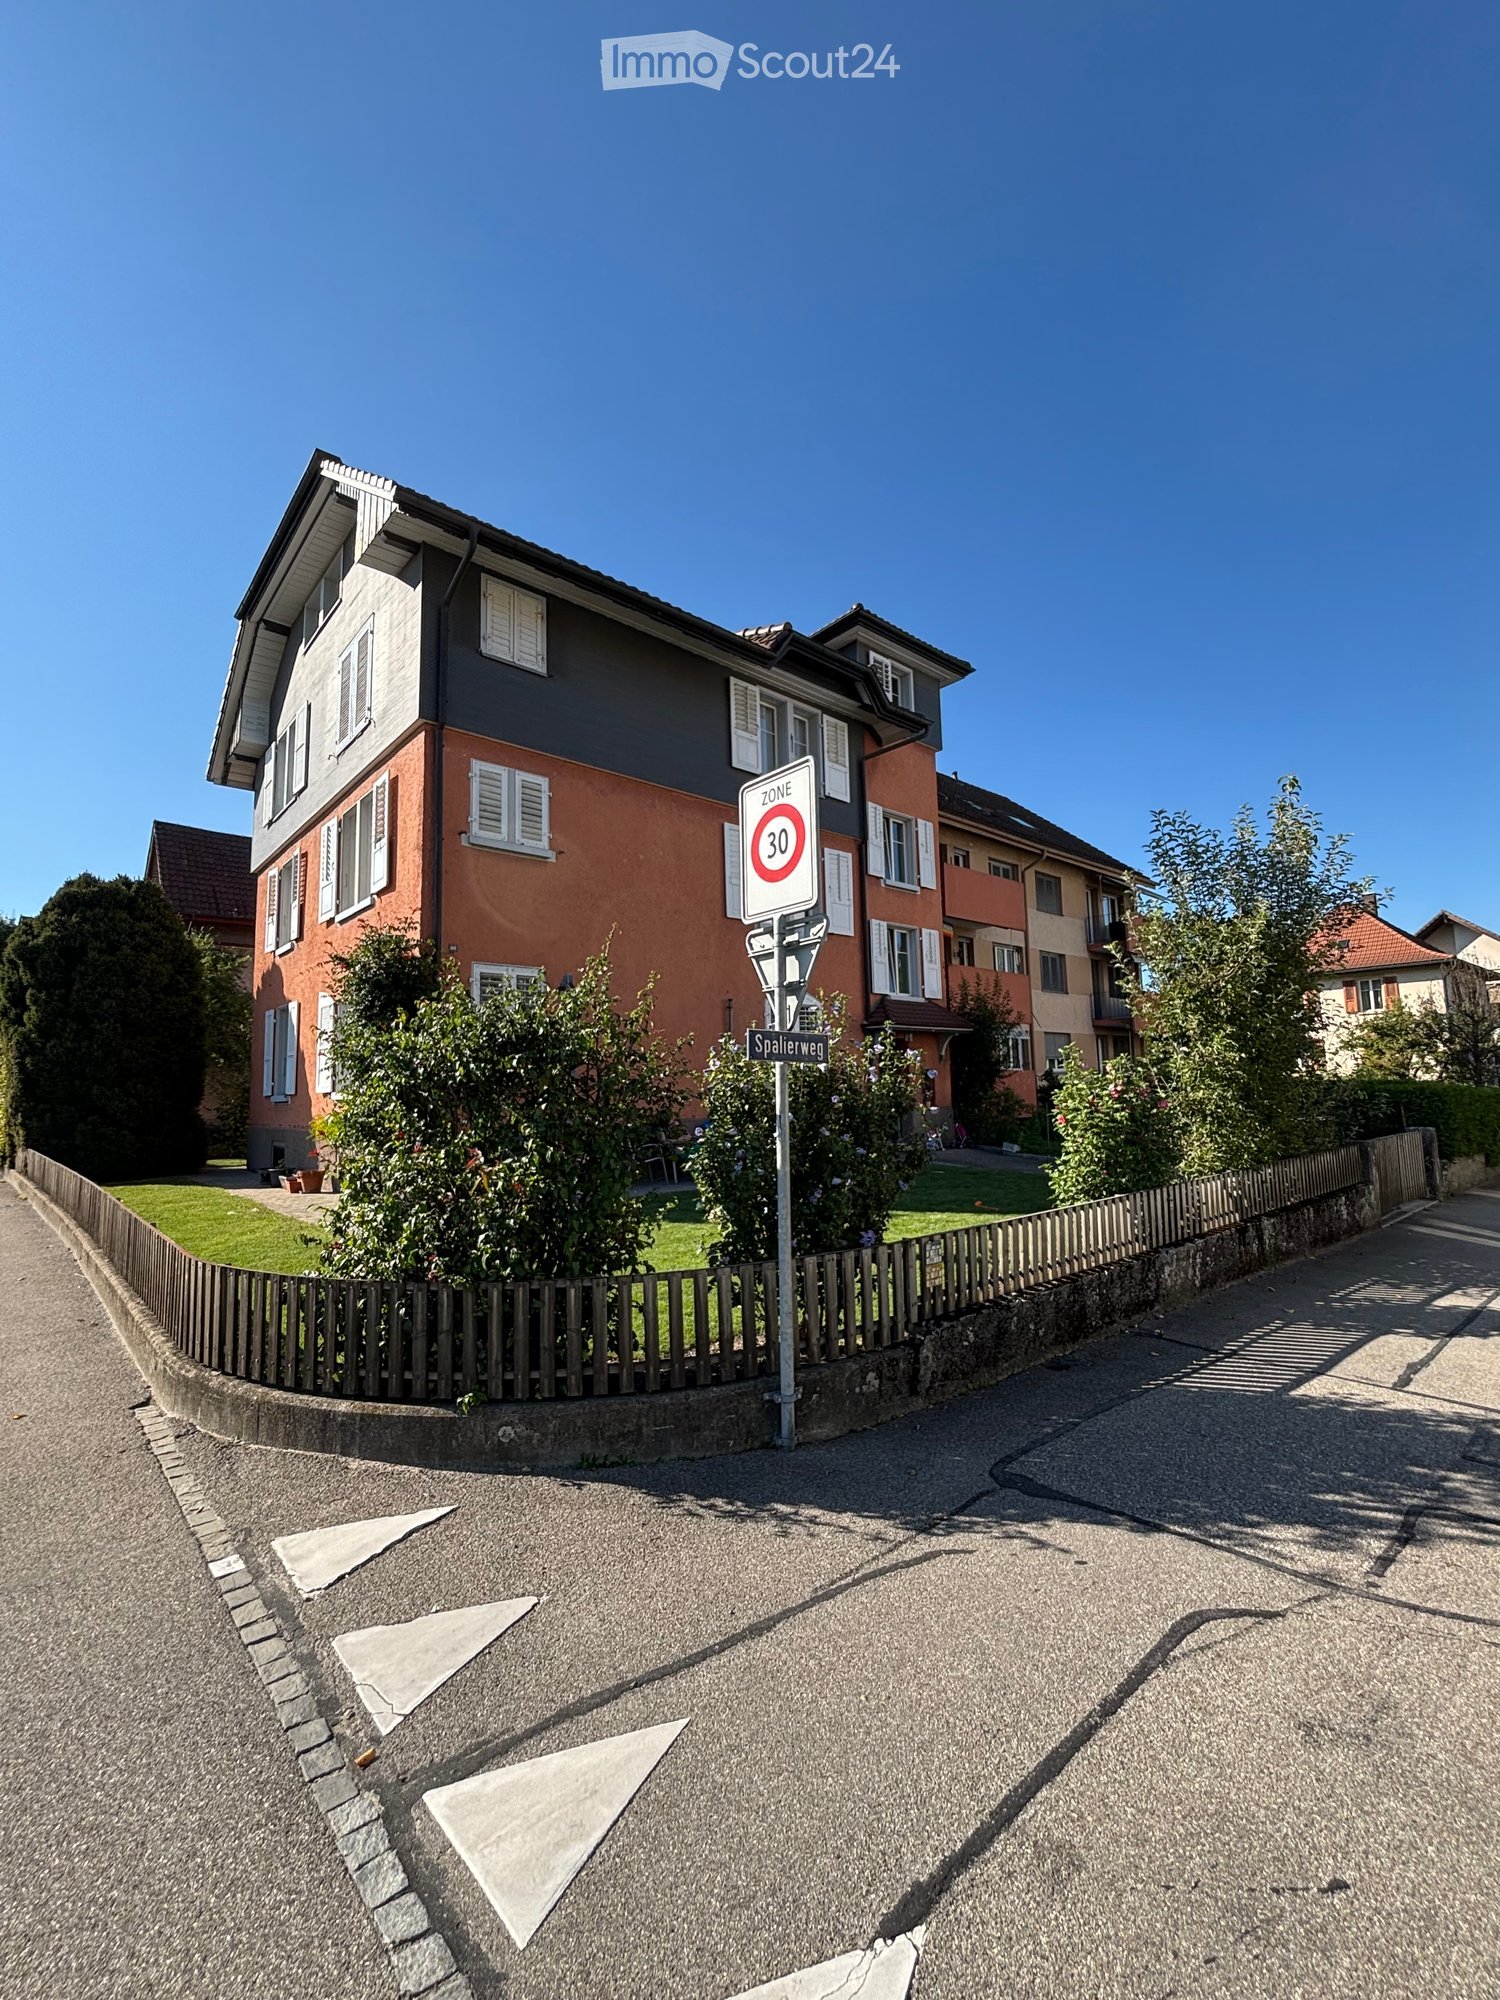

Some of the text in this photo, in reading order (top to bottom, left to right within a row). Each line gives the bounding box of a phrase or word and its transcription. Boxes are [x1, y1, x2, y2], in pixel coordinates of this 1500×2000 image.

[761, 780, 792, 807] ZONE
[766, 827, 789, 860] 30
[754, 1033, 825, 1061] Spalierweg
